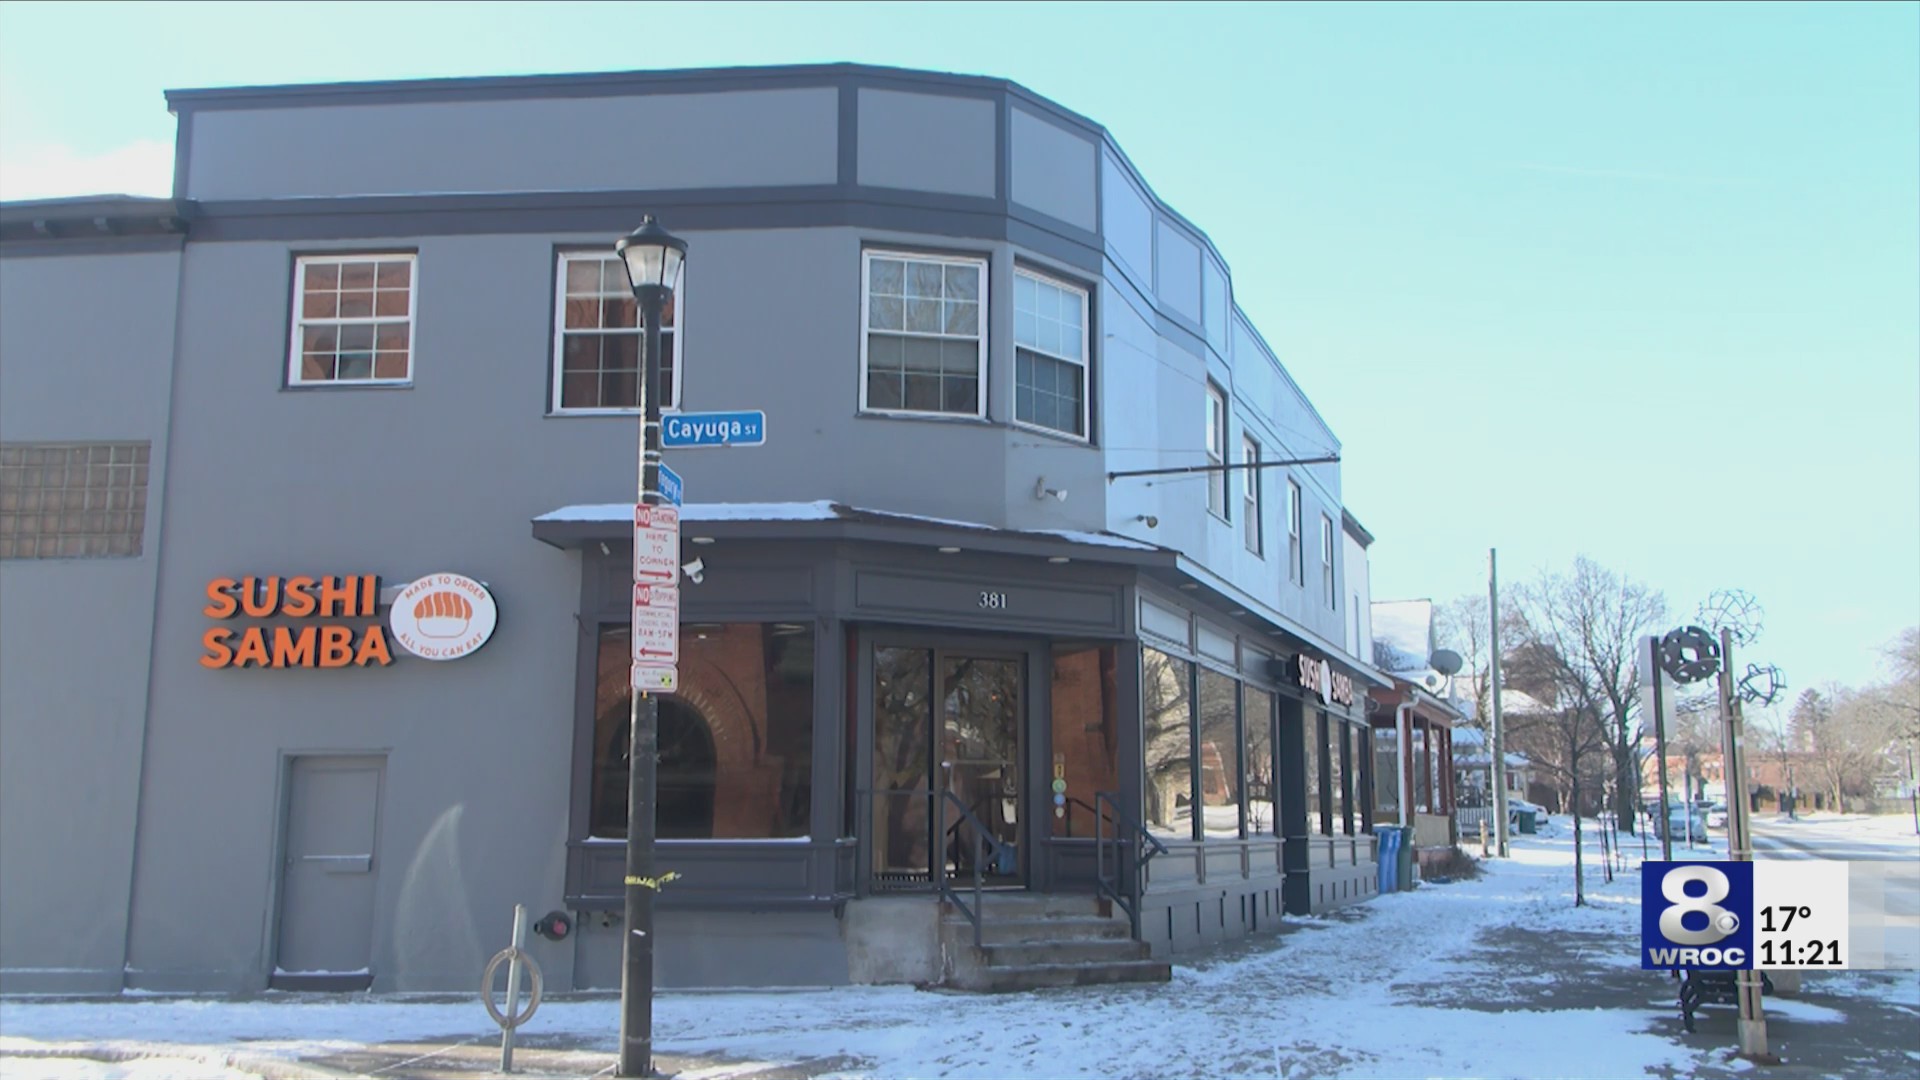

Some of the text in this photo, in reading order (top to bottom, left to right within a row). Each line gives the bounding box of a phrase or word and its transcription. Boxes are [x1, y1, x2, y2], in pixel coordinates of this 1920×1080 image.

[668, 419, 757, 442] Cayuga ST
[636, 508, 649, 525] NO
[646, 533, 668, 543] HERE
[652, 545, 663, 554] TO
[640, 555, 674, 567] CORNER
[203, 574, 378, 620] SUSHI
[405, 576, 486, 600] MADE TO ORDER
[636, 587, 649, 603] NO
[978, 591, 1007, 609] 381
[199, 624, 392, 669] SAMBA
[400, 632, 483, 657] ALL YOU CAN EAT
